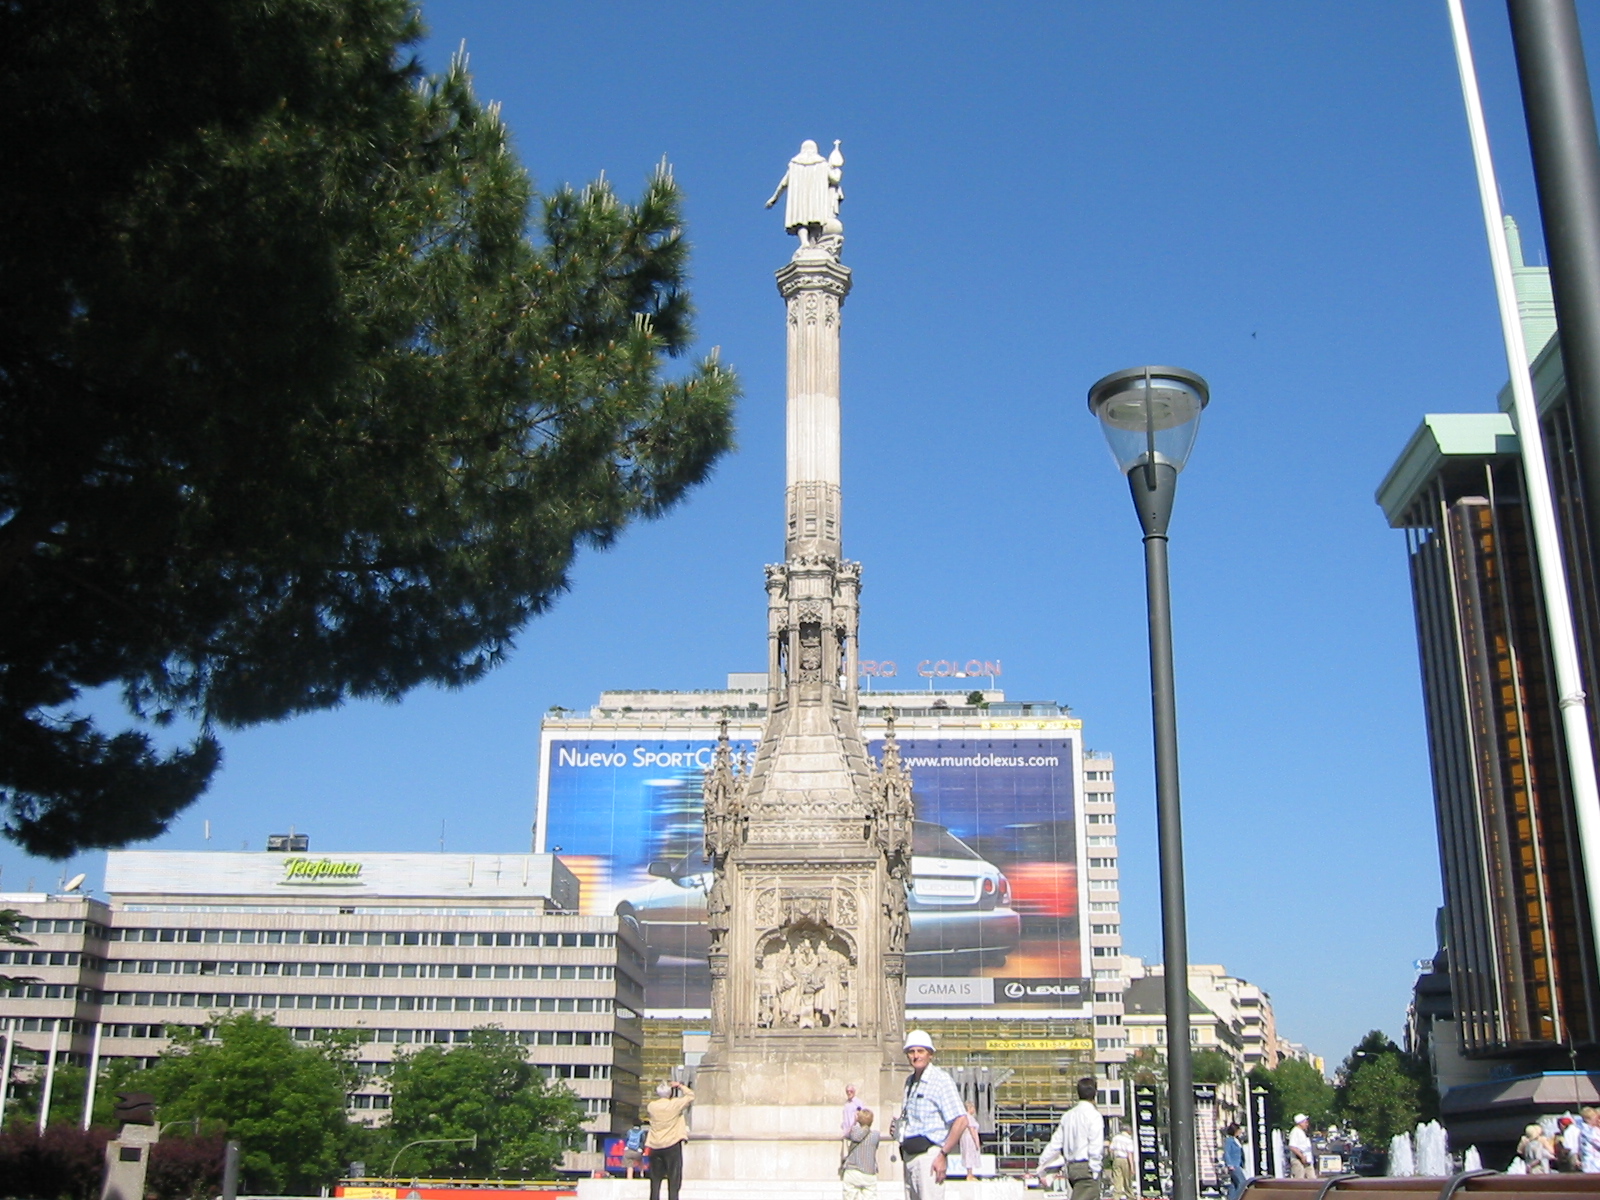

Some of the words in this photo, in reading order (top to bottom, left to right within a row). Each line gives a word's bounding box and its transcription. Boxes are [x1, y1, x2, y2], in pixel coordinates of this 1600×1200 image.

[917, 659, 1002, 677] COLON
[558, 747, 628, 767] Nuevo
[904, 752, 1060, 768] www.mundolexus.com
[918, 983, 957, 995] GAMA
[959, 983, 972, 995] IS
[1026, 984, 1081, 996] LEXUS
